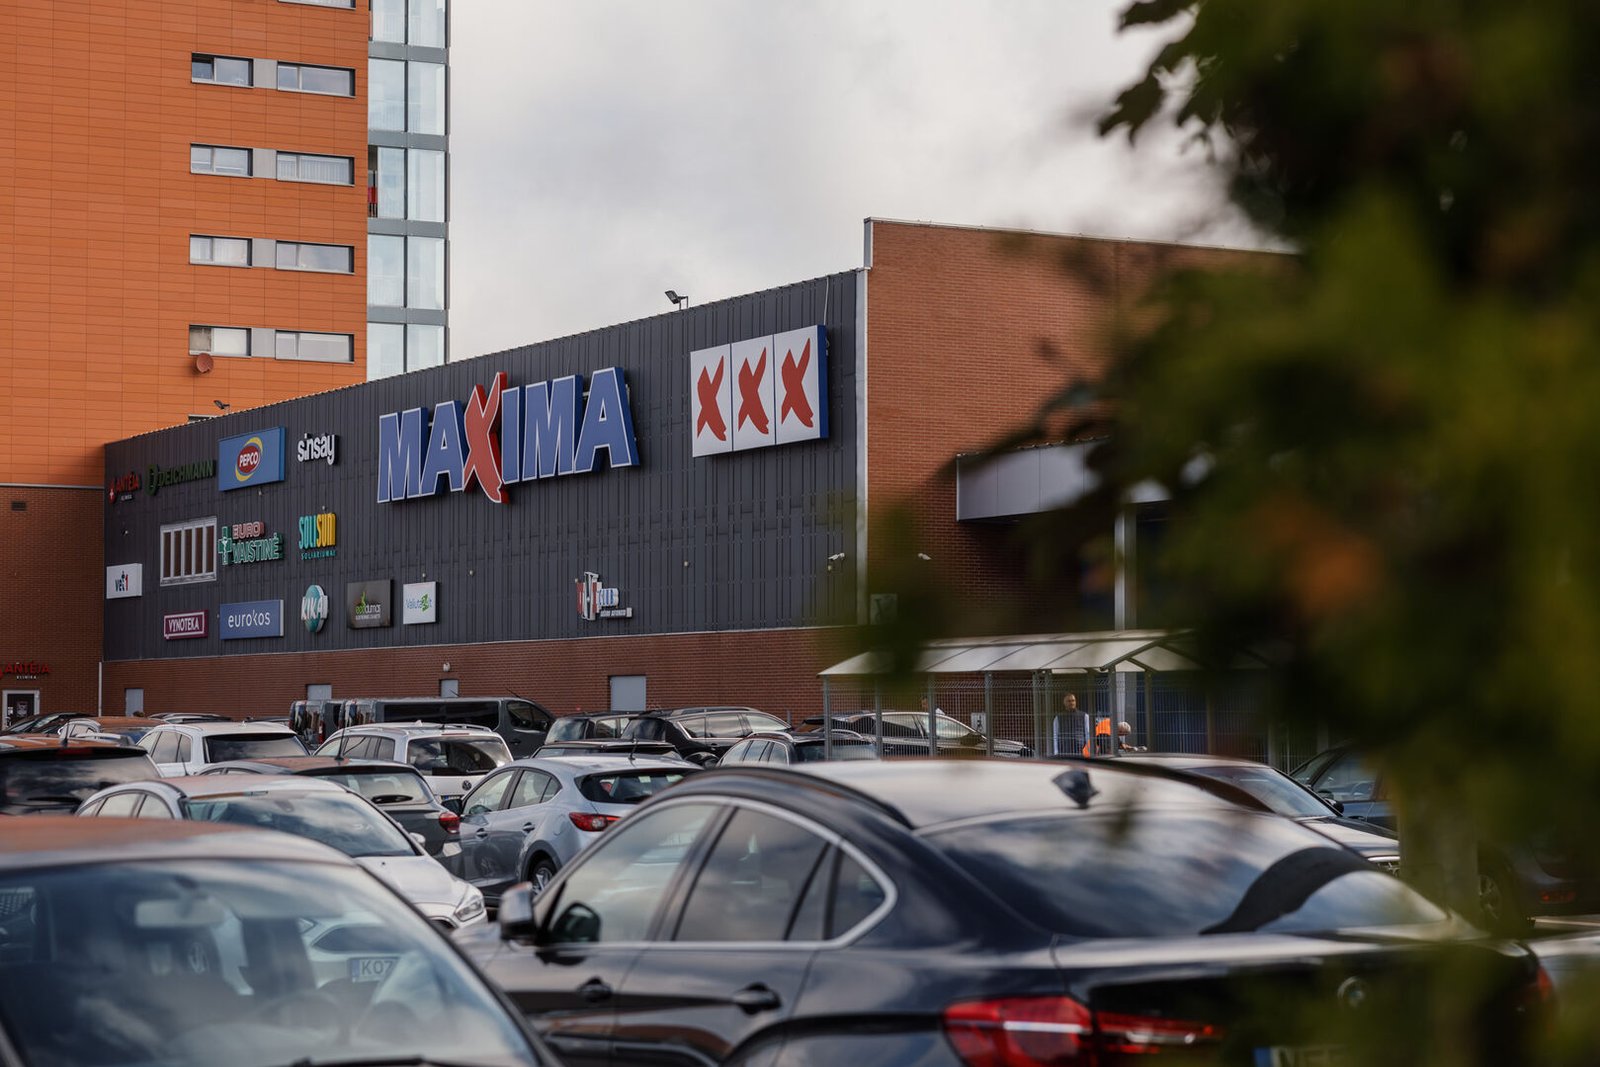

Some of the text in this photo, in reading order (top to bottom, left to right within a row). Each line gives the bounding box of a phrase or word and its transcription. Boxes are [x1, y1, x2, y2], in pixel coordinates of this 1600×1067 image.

[377, 368, 636, 504] MAXIMA
[239, 451, 259, 467] PEPCO
[297, 433, 335, 465] sinsay
[157, 460, 215, 487] DEICHMANN
[232, 521, 262, 539] EURO
[232, 533, 280, 564] VAISTINĖ
[228, 609, 271, 628] eurokos
[301, 595, 325, 620] KIKA
[168, 617, 199, 633] VYNOTEKA
